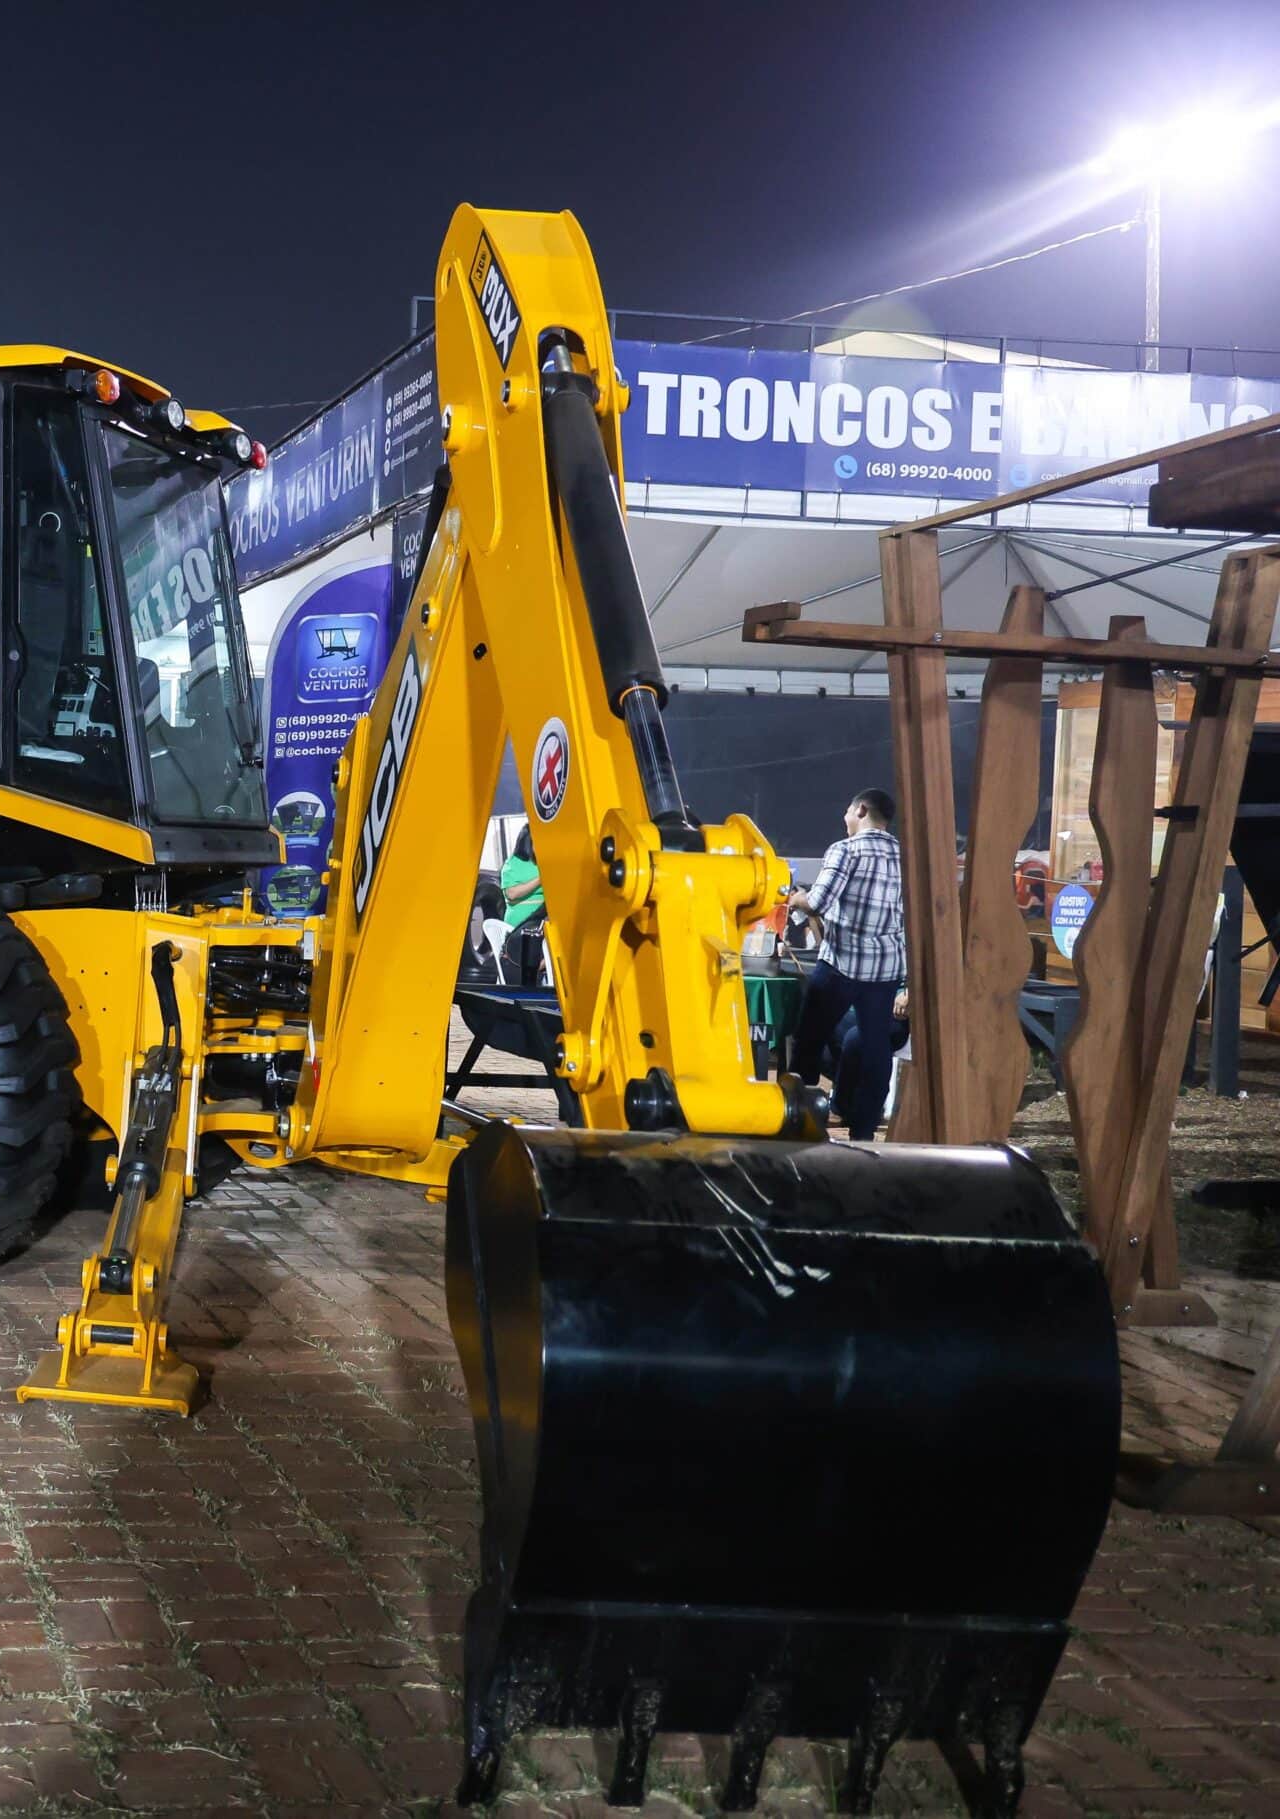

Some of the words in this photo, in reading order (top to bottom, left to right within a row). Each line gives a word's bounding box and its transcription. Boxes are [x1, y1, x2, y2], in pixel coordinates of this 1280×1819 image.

[637, 371, 953, 452] TRONCOS
[970, 391, 1003, 454] E
[865, 462, 897, 479] (68)
[899, 463, 993, 482] 99920-4000
[229, 484, 280, 558] OCHOS
[284, 418, 377, 528] VENTURIN
[308, 665, 368, 679] COCHOS
[303, 678, 369, 692] VENTURIN
[288, 711, 369, 728] (68)99920-400
[287, 728, 354, 742] (69)99265-
[286, 745, 345, 758] @cochos.
[355, 653, 420, 914] JCB
